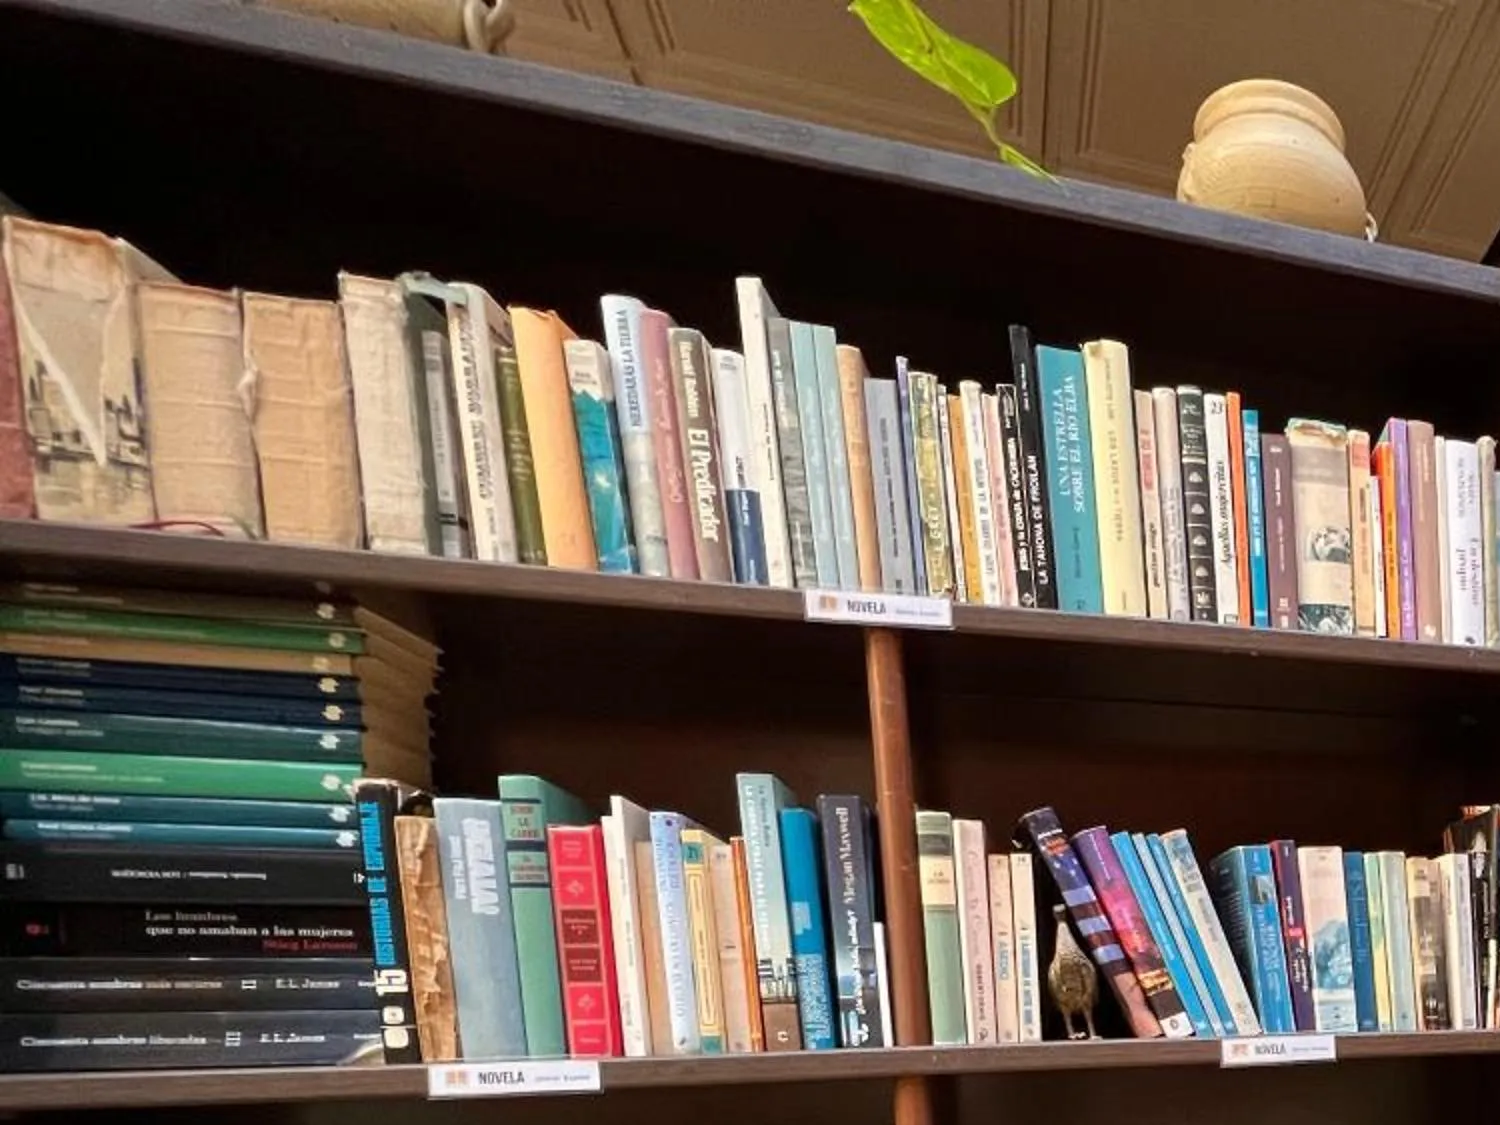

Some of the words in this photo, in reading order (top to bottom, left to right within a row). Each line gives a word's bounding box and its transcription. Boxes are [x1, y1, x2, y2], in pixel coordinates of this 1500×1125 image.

[1053, 387, 1068, 461] ESTRELLA
[689, 428, 711, 445] El
[1069, 444, 1081, 462] EL
[1058, 465, 1071, 496] UNA
[692, 447, 721, 542] Predicador
[1071, 467, 1085, 513] SOBRE
[1032, 504, 1042, 520] DE
[1033, 523, 1046, 567] TAHONA
[1037, 570, 1049, 584] LA
[847, 600, 886, 615] NOVELA
[835, 807, 852, 860] Maxwell
[145, 925, 174, 937] que
[199, 925, 257, 936] amaban
[298, 927, 354, 939] mujeres
[373, 968, 409, 997] 15
[1255, 1044, 1286, 1055] NOVELA
[478, 1071, 525, 1085] NOVELA
